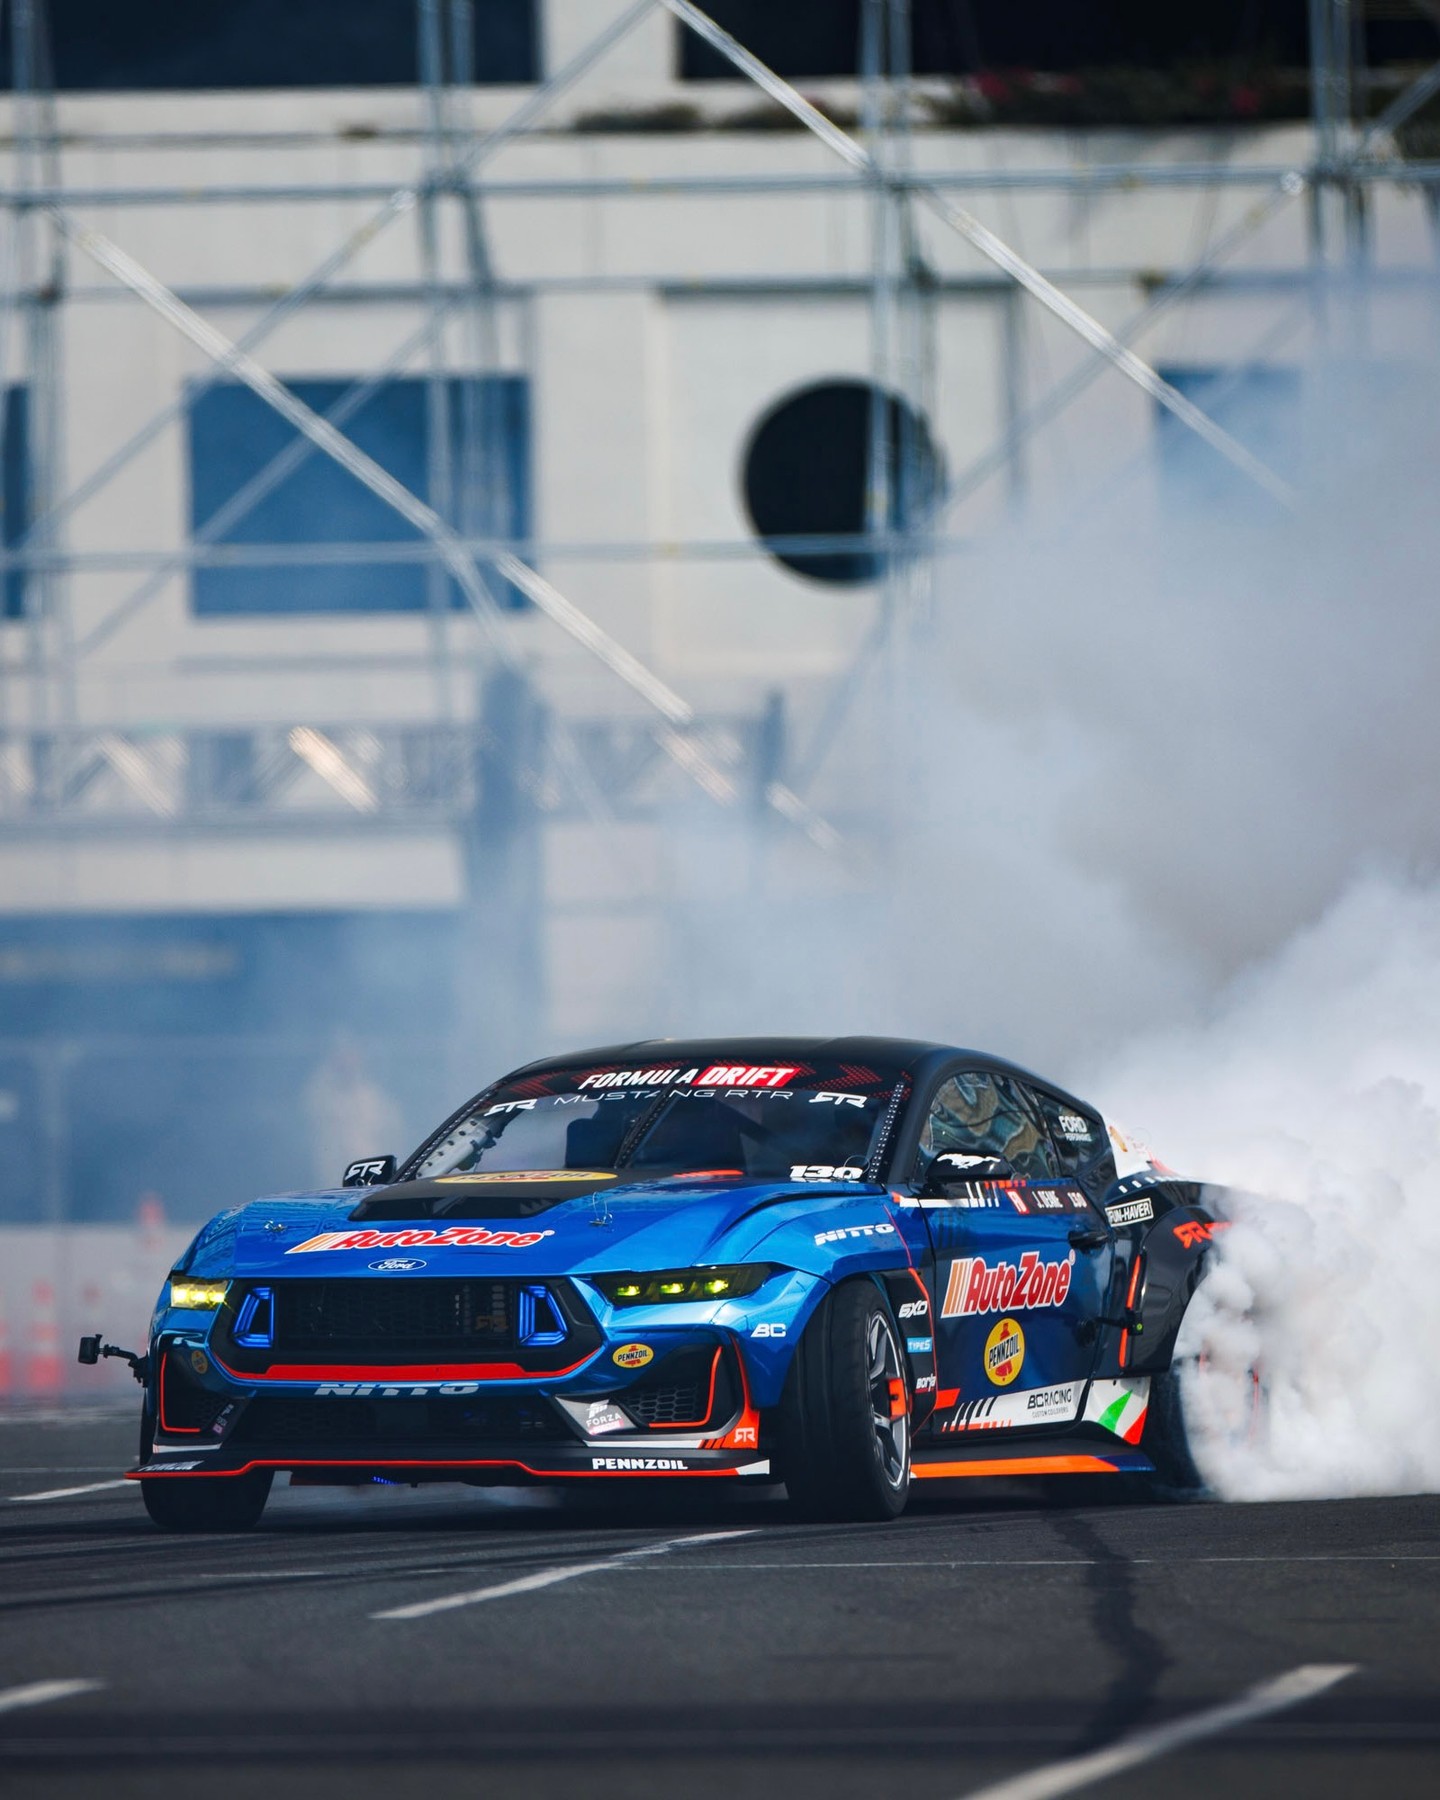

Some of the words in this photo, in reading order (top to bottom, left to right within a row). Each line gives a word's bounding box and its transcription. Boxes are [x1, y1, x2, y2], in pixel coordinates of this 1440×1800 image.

[578, 1068, 699, 1090] FORMULA
[698, 1066, 795, 1086] DRIFT
[725, 1089, 794, 1100] RTR
[1058, 1115, 1088, 1133] FORD
[789, 1165, 863, 1180] 130
[329, 1227, 544, 1249] AutoZone
[814, 1223, 896, 1246] NITTO
[378, 1260, 416, 1270] Ford
[963, 1251, 1072, 1315] AutoZone
[750, 1323, 787, 1338] BC
[617, 1350, 648, 1362] PENNZOIL
[989, 1334, 1019, 1370] PENNZOIL
[314, 1383, 480, 1396] NITTO
[586, 1413, 622, 1427] FORZA
[592, 1458, 688, 1470] PENNZOIL
